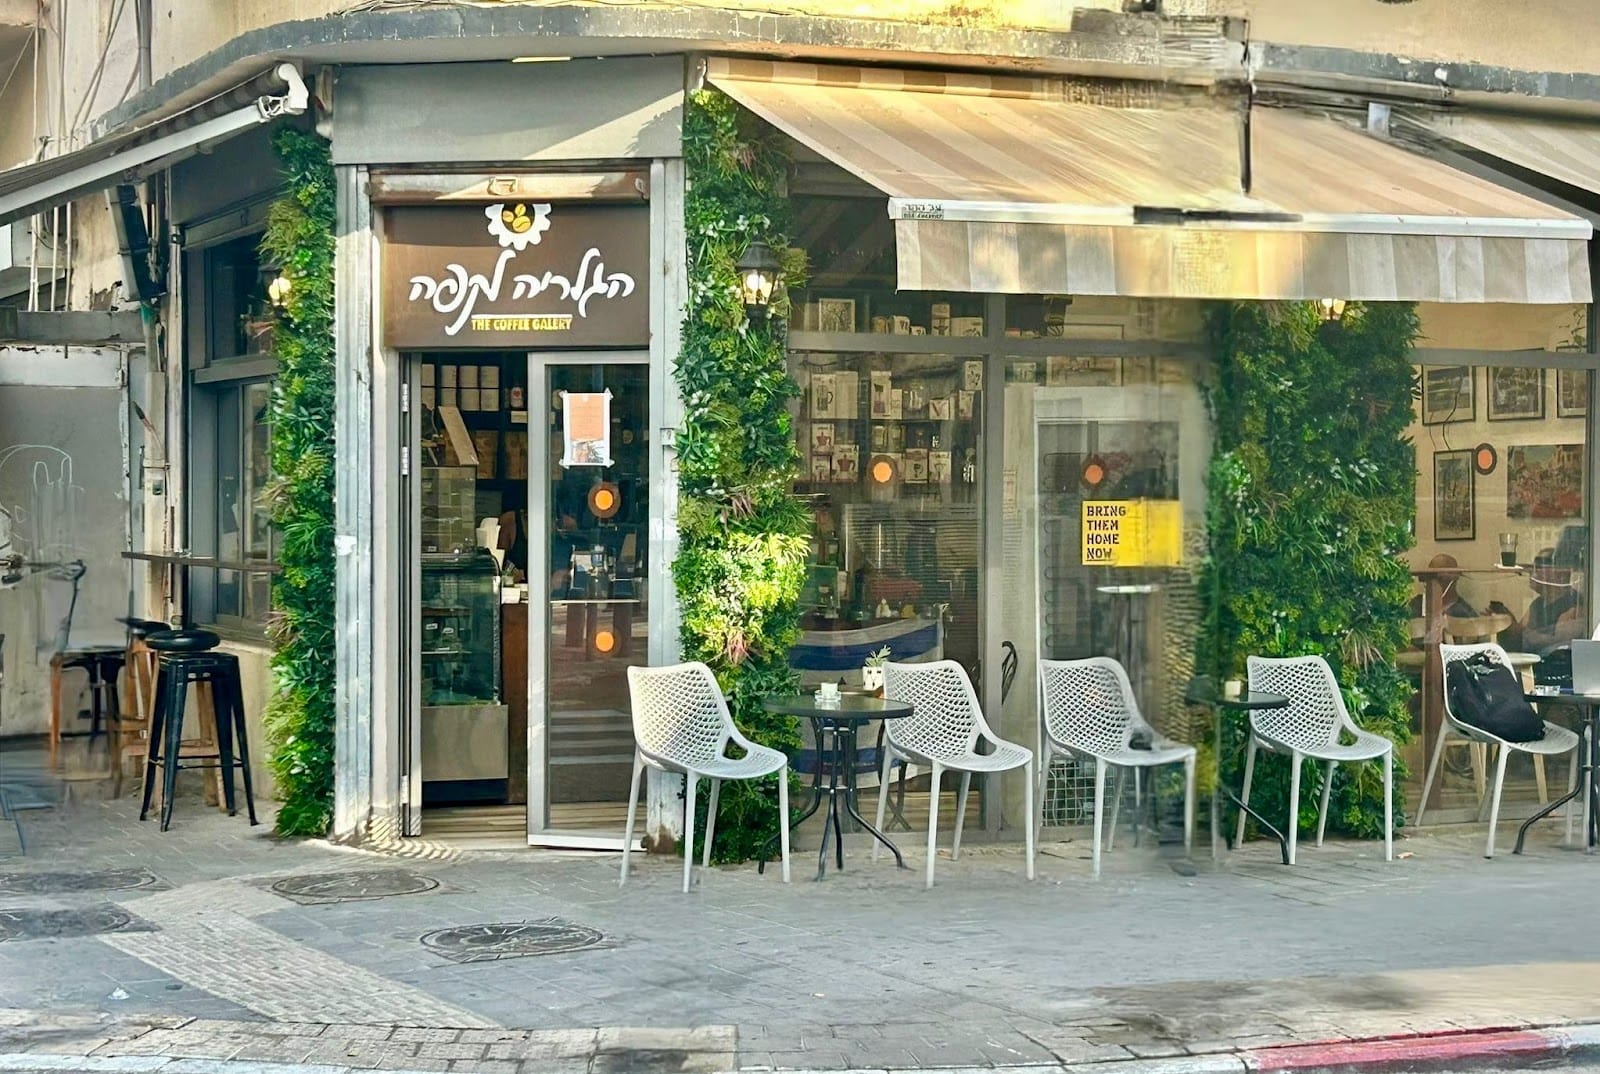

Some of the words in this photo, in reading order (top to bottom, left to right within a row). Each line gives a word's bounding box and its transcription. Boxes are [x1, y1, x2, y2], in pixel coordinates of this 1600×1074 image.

[512, 247, 636, 318] הגלריה
[408, 248, 517, 336] לקפה
[471, 318, 491, 331] THE
[493, 318, 530, 331] COFFEE
[1086, 505, 1127, 517] BRING
[1086, 519, 1119, 531] THEM
[1086, 533, 1120, 545] HOME
[1086, 547, 1113, 560] NOW
